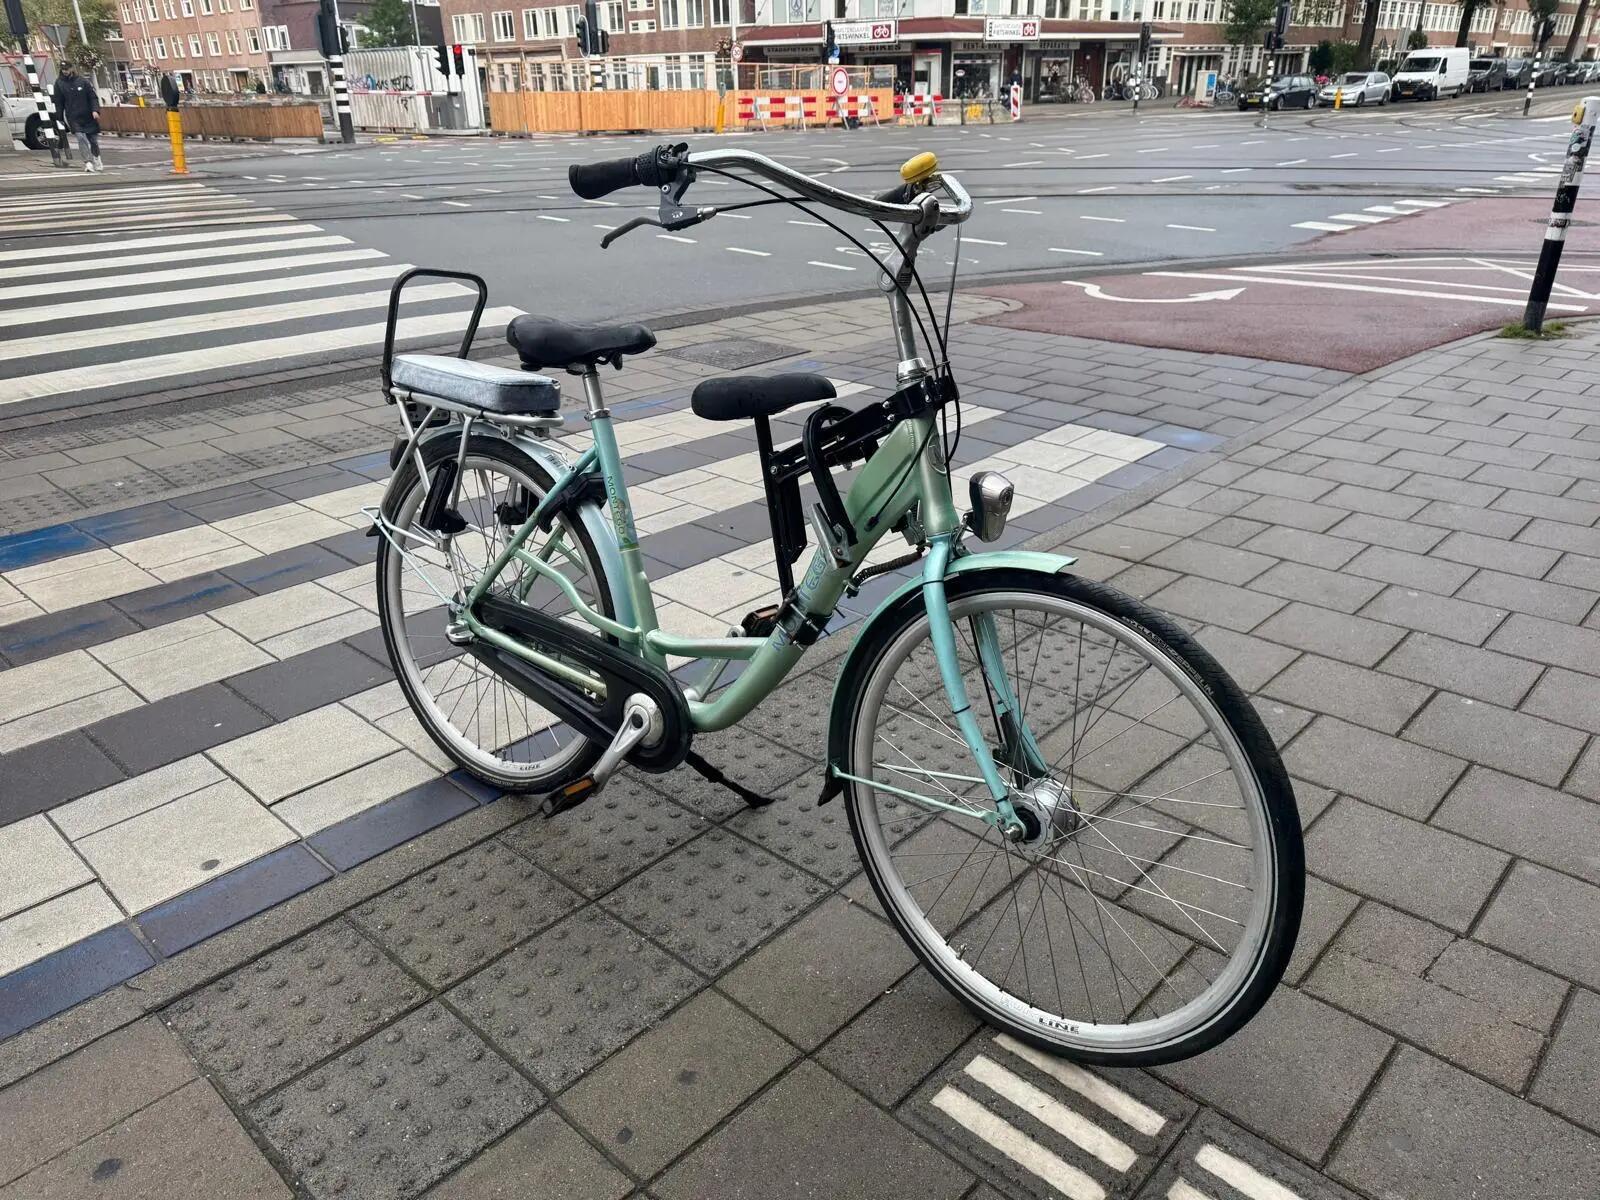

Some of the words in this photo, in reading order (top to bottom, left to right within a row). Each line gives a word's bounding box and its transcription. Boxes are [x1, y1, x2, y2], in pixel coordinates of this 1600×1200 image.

[858, 44, 901, 52] E-BIKES
[1172, 649, 1214, 696] ZEPPELIN
[1039, 1017, 1080, 1035] LINE
